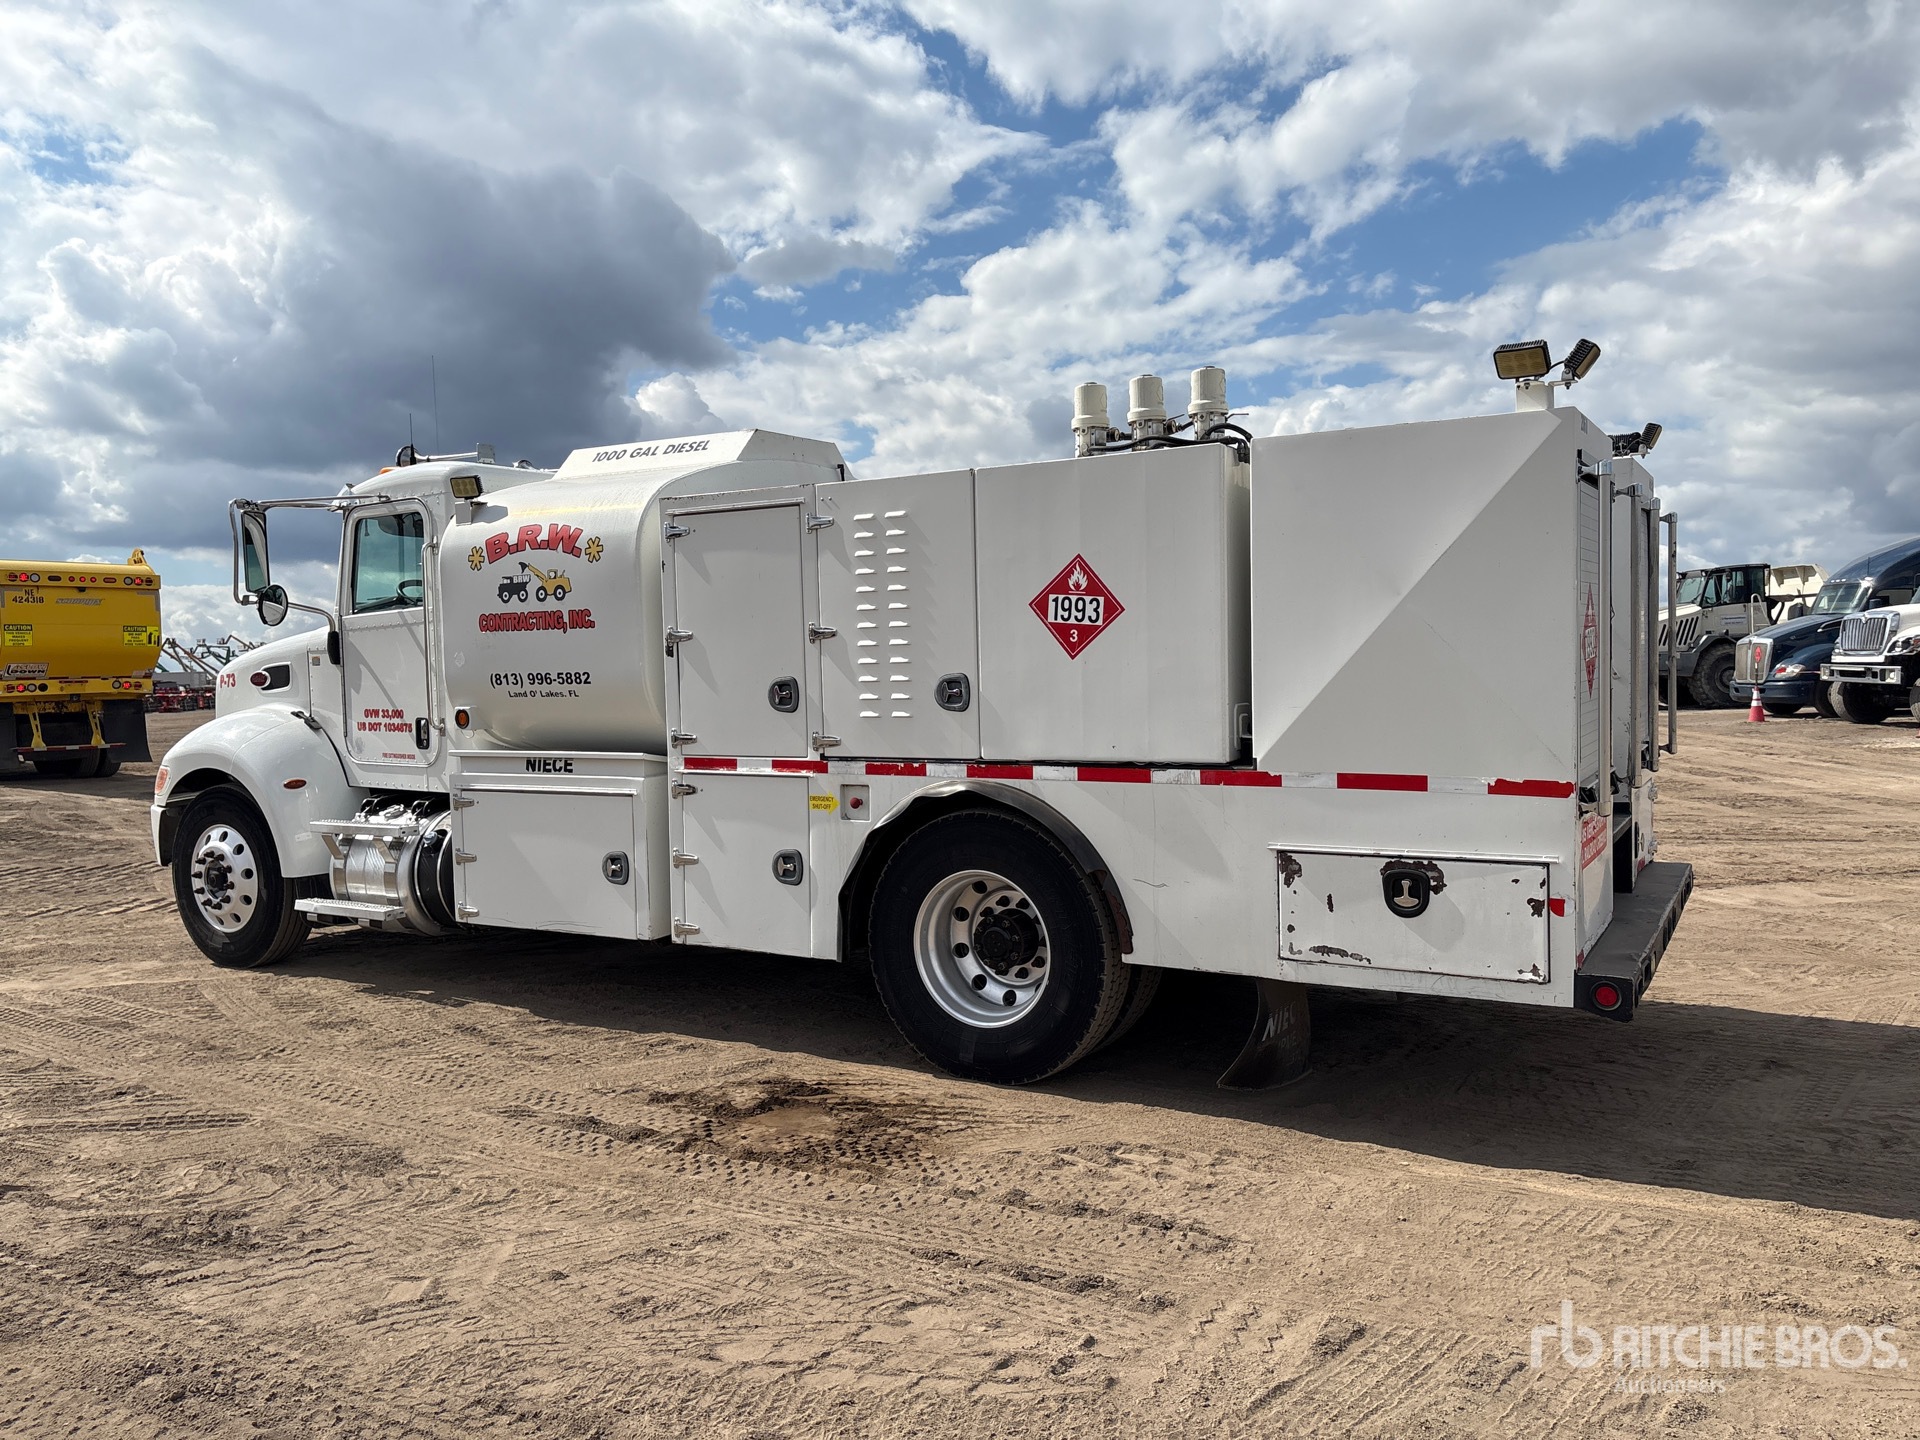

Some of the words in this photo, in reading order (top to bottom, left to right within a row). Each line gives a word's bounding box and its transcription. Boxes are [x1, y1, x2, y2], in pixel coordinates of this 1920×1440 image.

[592, 449, 627, 463] 1000
[629, 445, 659, 459] GAL
[662, 440, 710, 455] DIESEL
[485, 523, 583, 564] B.R.W.
[513, 574, 531, 584] BRW
[12, 596, 44, 604] 424318
[24, 589, 34, 597] NE
[1051, 595, 1101, 624] 1993
[479, 609, 567, 634] CONTRACTING,
[568, 608, 595, 629] INC.
[1069, 629, 1078, 643] 3
[220, 673, 236, 688] P-73
[490, 672, 523, 689] (813)
[527, 671, 591, 685] 996-5882
[508, 690, 528, 698] Land
[568, 689, 580, 698] FL
[368, 722, 382, 732] DOT
[525, 758, 574, 773] NIECE
